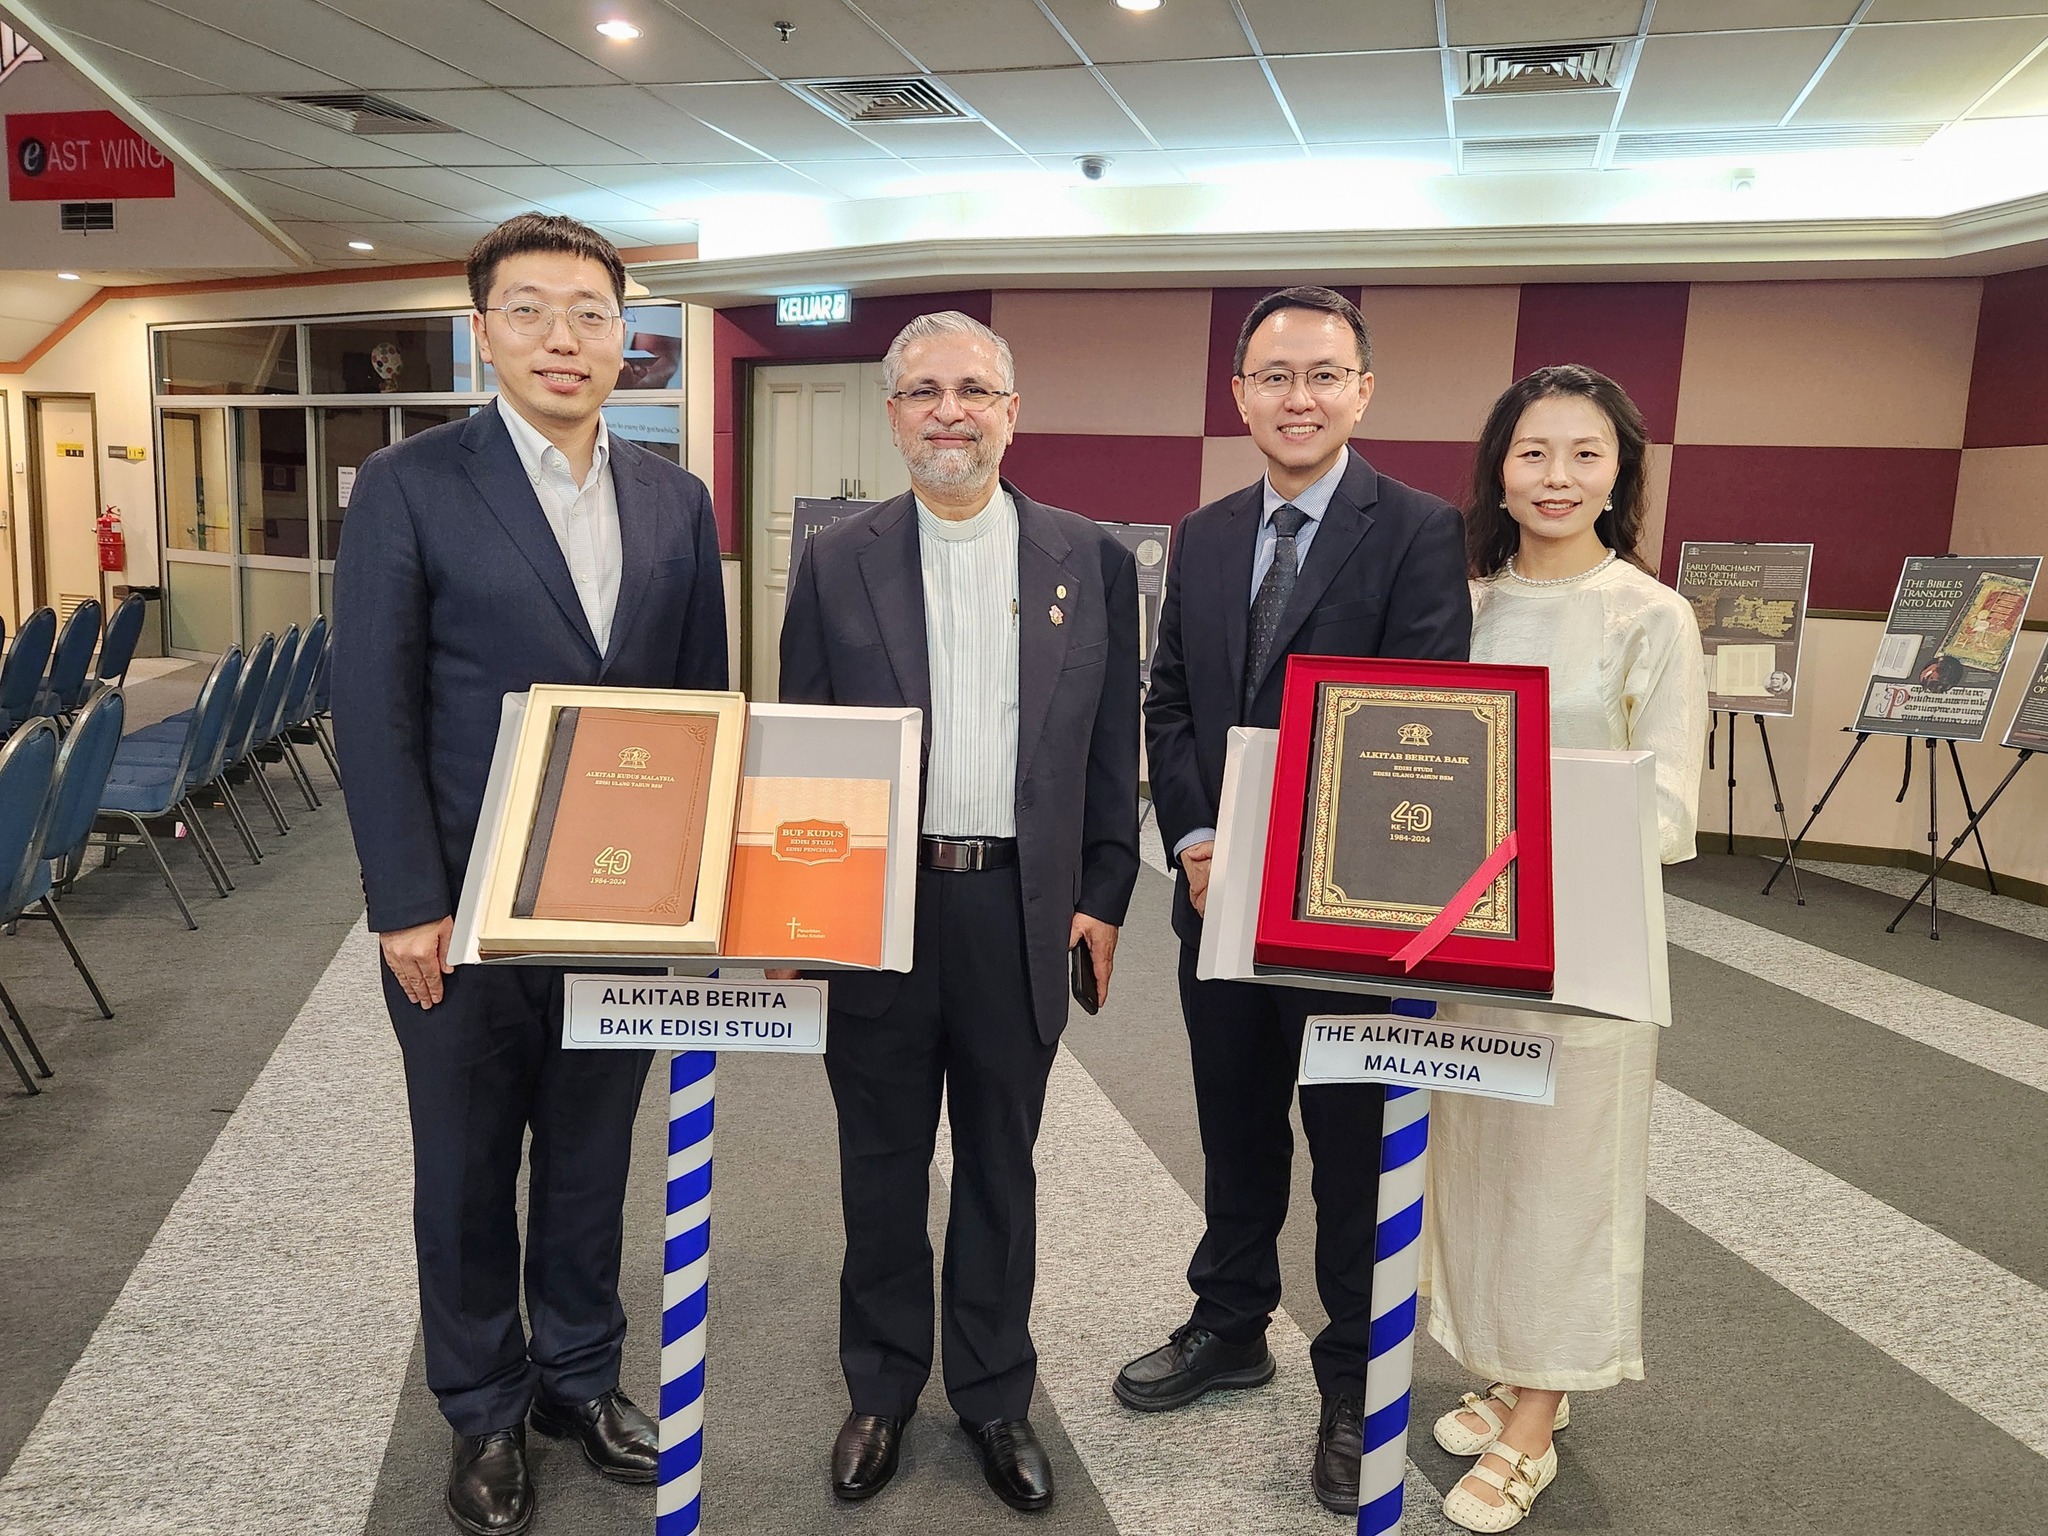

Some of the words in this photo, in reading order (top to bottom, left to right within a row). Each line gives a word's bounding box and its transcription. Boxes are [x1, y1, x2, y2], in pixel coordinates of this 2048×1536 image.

[100, 138, 165, 169] WING
[780, 295, 832, 322] KELUAR
[1686, 562, 1709, 570] EARLY
[1710, 563, 1762, 572] PARCHMENT
[1685, 570, 1708, 578] TEXTS
[1709, 571, 1721, 579] OF
[1683, 577, 1706, 586] NEW
[1708, 578, 1760, 587] TESTAMENT
[1905, 579, 1925, 589] THE
[1926, 579, 1953, 589] BIBLE
[1953, 580, 1964, 588] IS
[1902, 589, 1963, 599] TRANSLATED
[1899, 599, 1924, 608] INTO
[1925, 599, 1955, 608] LATIN
[1359, 750, 1403, 760] ALKITAB
[1404, 753, 1442, 763] BERITA
[1443, 756, 1470, 764] BAIK
[586, 771, 616, 779] ALKITAB
[1391, 800, 1432, 831] 40
[781, 828, 804, 837] BUP
[807, 829, 844, 838] KUDUS
[1390, 833, 1431, 843] 1984-2024
[594, 846, 632, 875] 40
[590, 877, 627, 885] 1984-2024
[601, 988, 700, 1006] ALKITAB
[706, 990, 787, 1008] BERITA
[600, 1018, 654, 1035] BAIK
[660, 1019, 719, 1036] EDISI
[725, 1020, 792, 1038] STUDI
[1314, 1025, 1356, 1042] THE
[1360, 1026, 1454, 1049] ALKITAB
[1460, 1034, 1542, 1059] KUDUS
[1364, 1055, 1481, 1082] MALAYSIA
